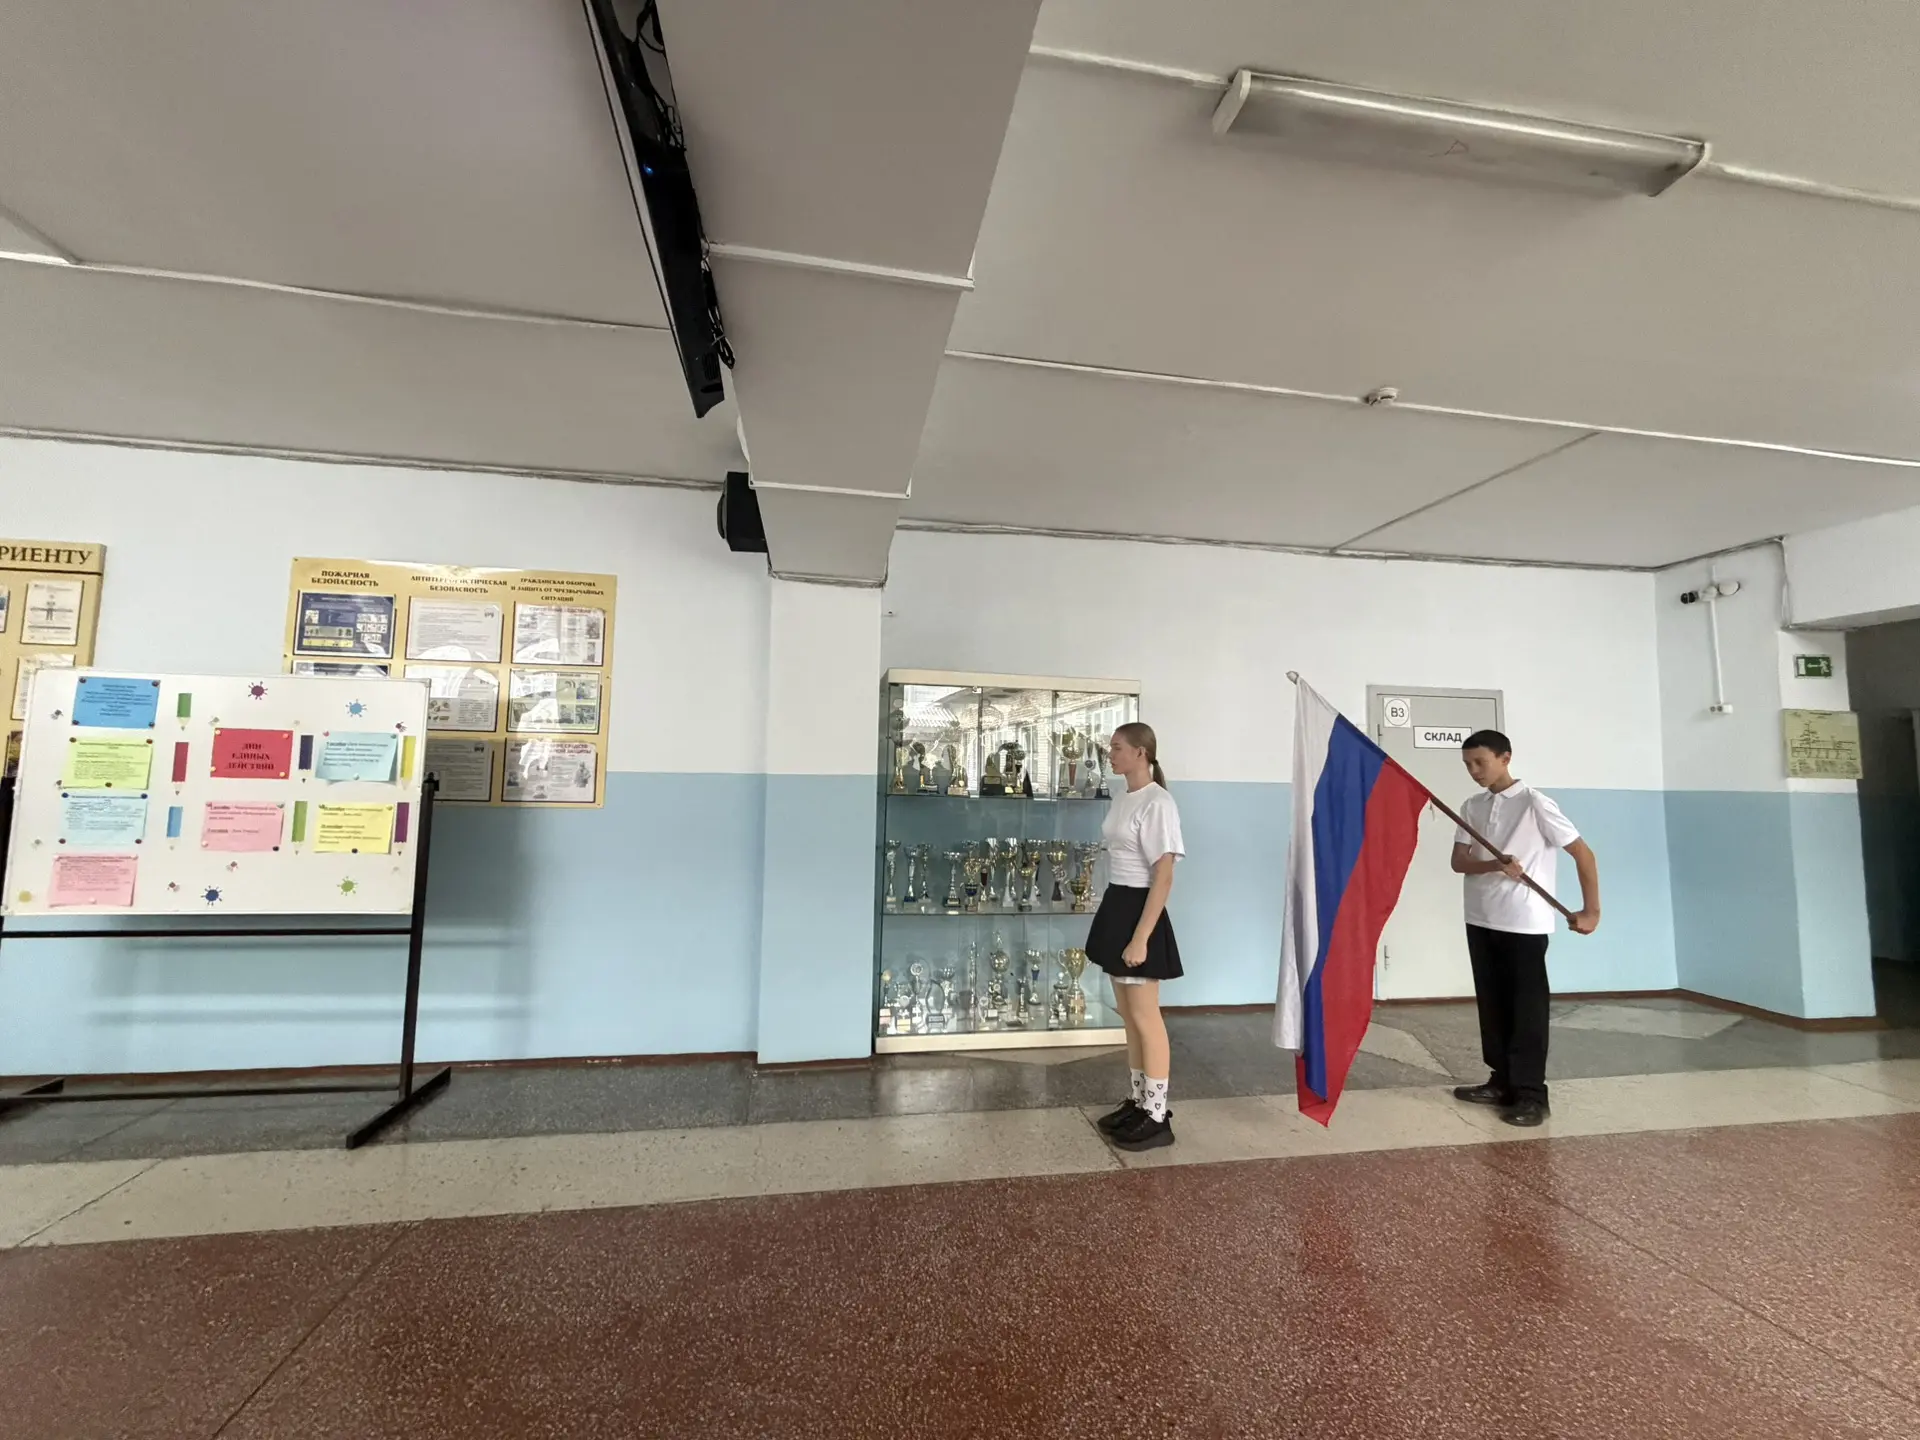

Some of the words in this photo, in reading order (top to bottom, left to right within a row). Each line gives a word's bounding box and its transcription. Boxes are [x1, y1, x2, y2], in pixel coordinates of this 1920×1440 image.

[321, 570, 370, 579] ПОЖАРНАЯ
[311, 577, 379, 587] БЕЗОПАСНОСТЬ
[520, 577, 565, 585] ГРАЖДАНСКАЯ
[429, 585, 489, 594] БЕЗОПАСНОСТЬ
[553, 587, 605, 596] ЧРЕЗВЫЧАЙНЫХ
[1390, 706, 1405, 718] В3
[1424, 731, 1463, 743] СКЛАД
